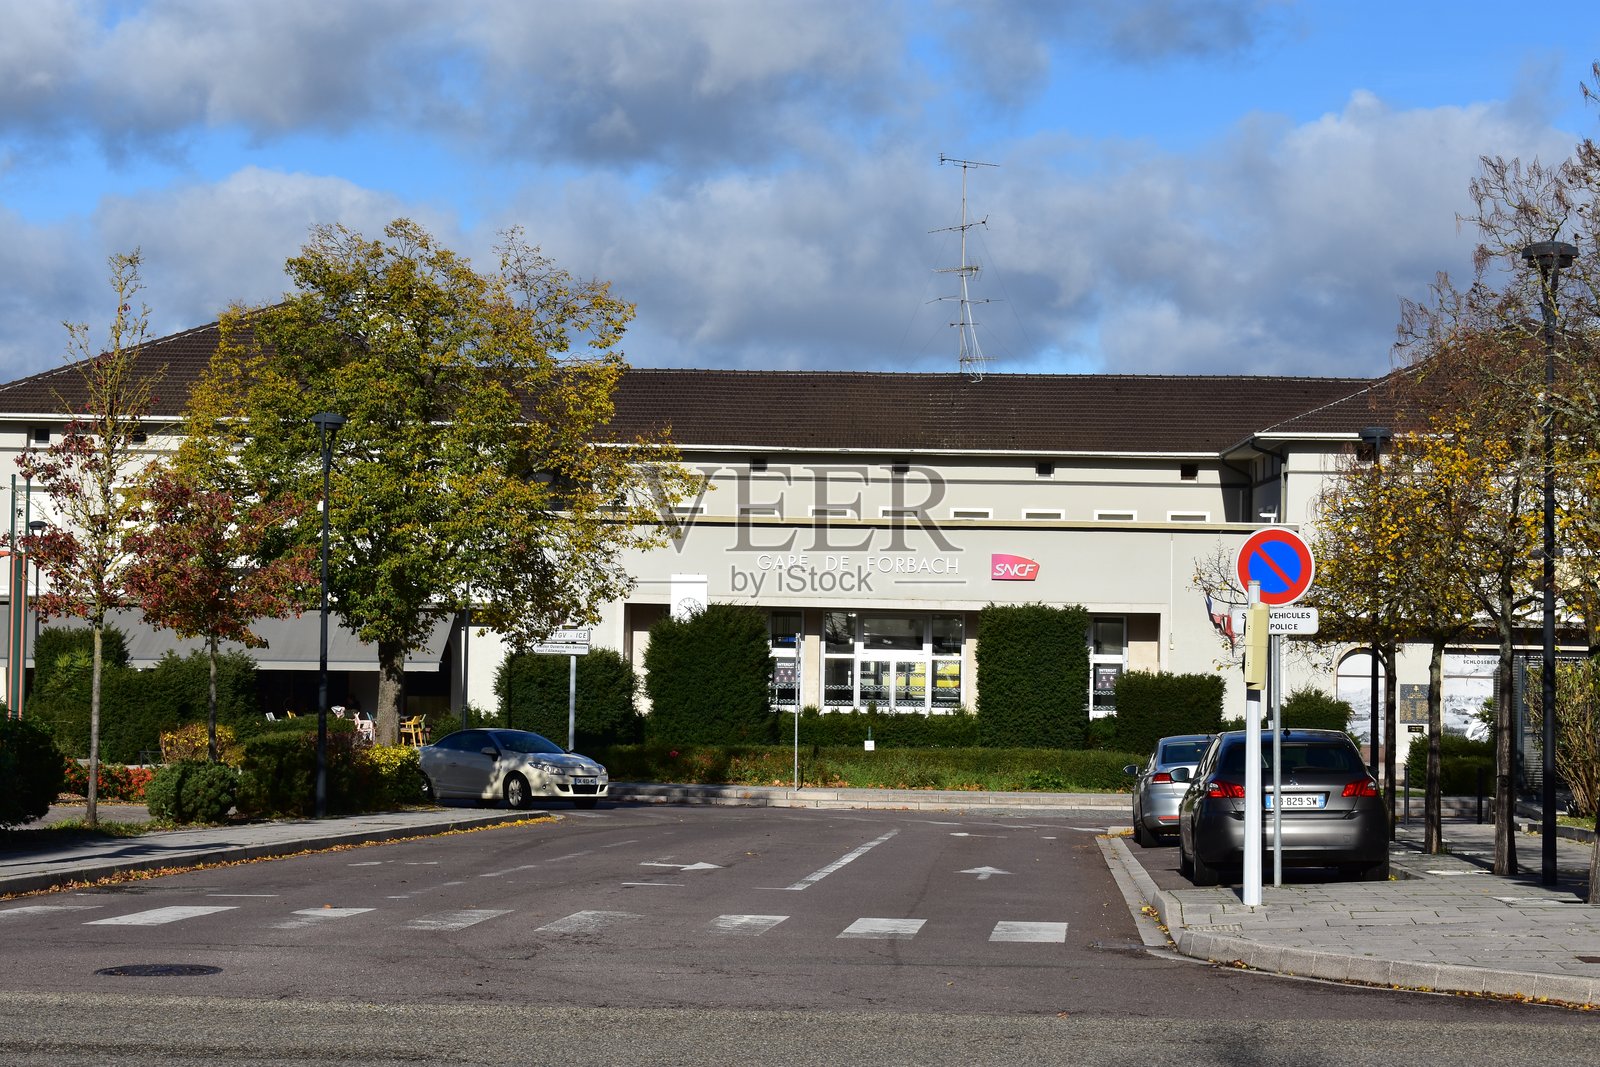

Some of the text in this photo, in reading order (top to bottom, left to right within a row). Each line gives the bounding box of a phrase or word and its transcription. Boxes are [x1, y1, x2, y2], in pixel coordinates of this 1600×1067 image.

[756, 554, 959, 574] GARE DE FORBACH
[993, 563, 1036, 577] SNCF
